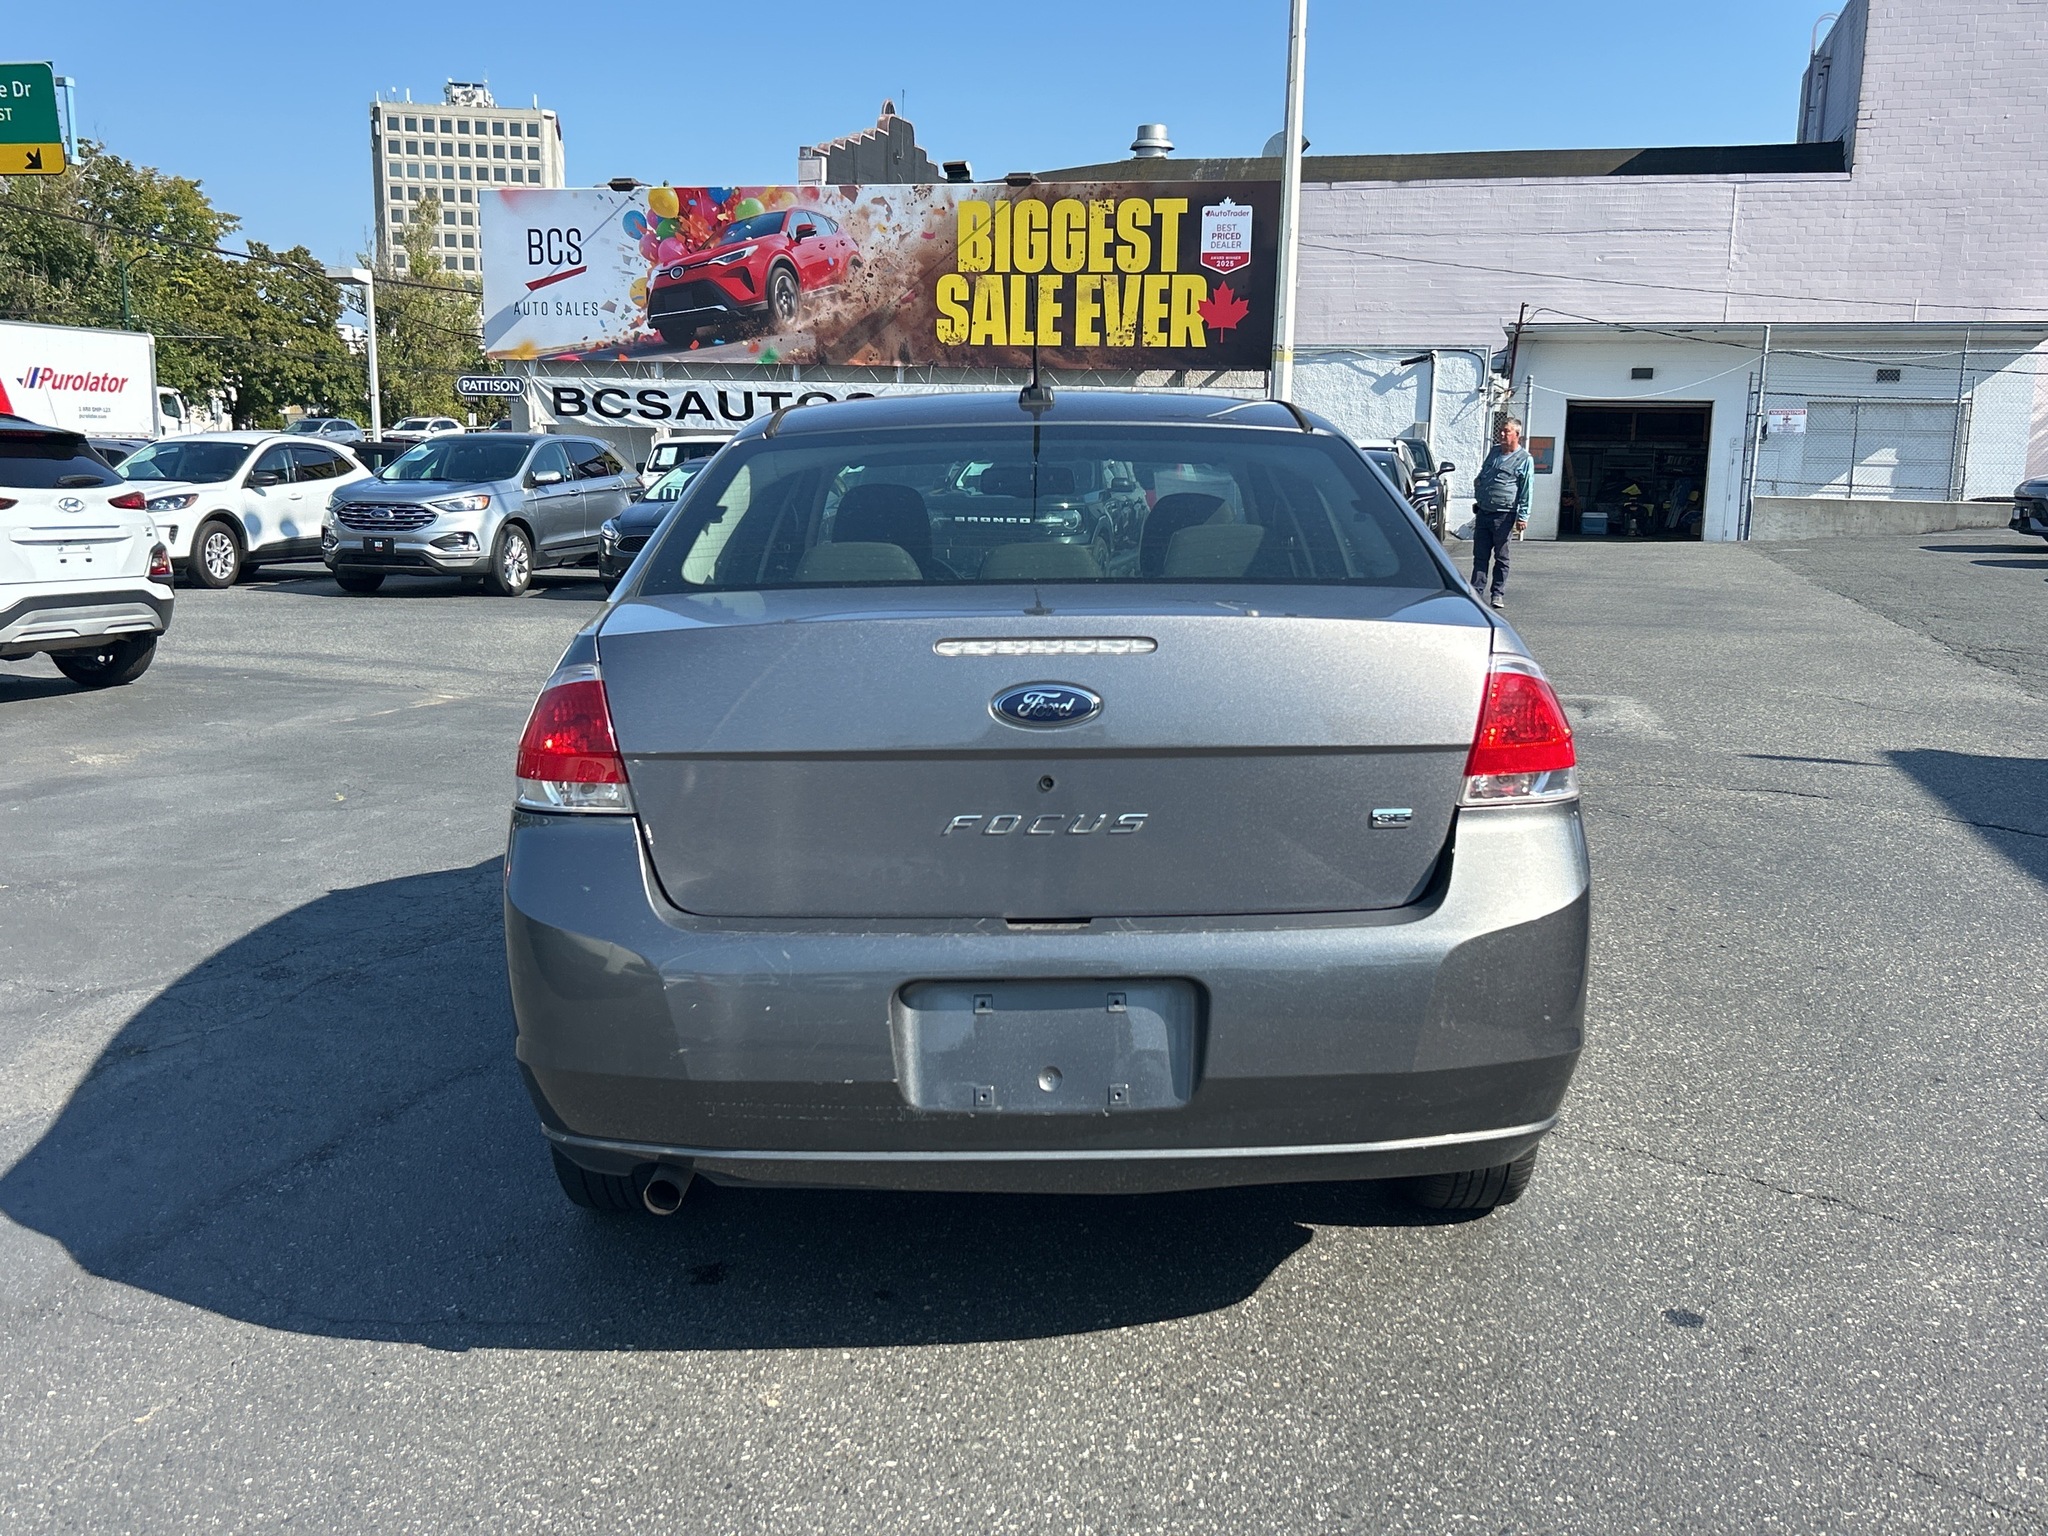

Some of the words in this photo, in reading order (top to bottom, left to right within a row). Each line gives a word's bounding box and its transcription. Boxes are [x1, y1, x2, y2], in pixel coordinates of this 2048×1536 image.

[11, 80, 31, 98] Dr
[957, 198, 1188, 274] BIGGEST
[1211, 232, 1242, 240] PRICED
[1216, 223, 1237, 232] BEST
[527, 227, 582, 266] BCS
[1210, 240, 1242, 249] DEALER
[513, 301, 549, 316] AUTO
[555, 301, 599, 317] SALES
[935, 274, 1063, 348] SALE
[1075, 274, 1208, 348] EVER
[37, 367, 129, 394] Purolator
[462, 380, 520, 392] PATTISON
[552, 386, 875, 422] BCSAUT
[954, 516, 1031, 524] BRONCO
[1017, 691, 1077, 717] Ford
[942, 812, 1150, 836] FOCUS
